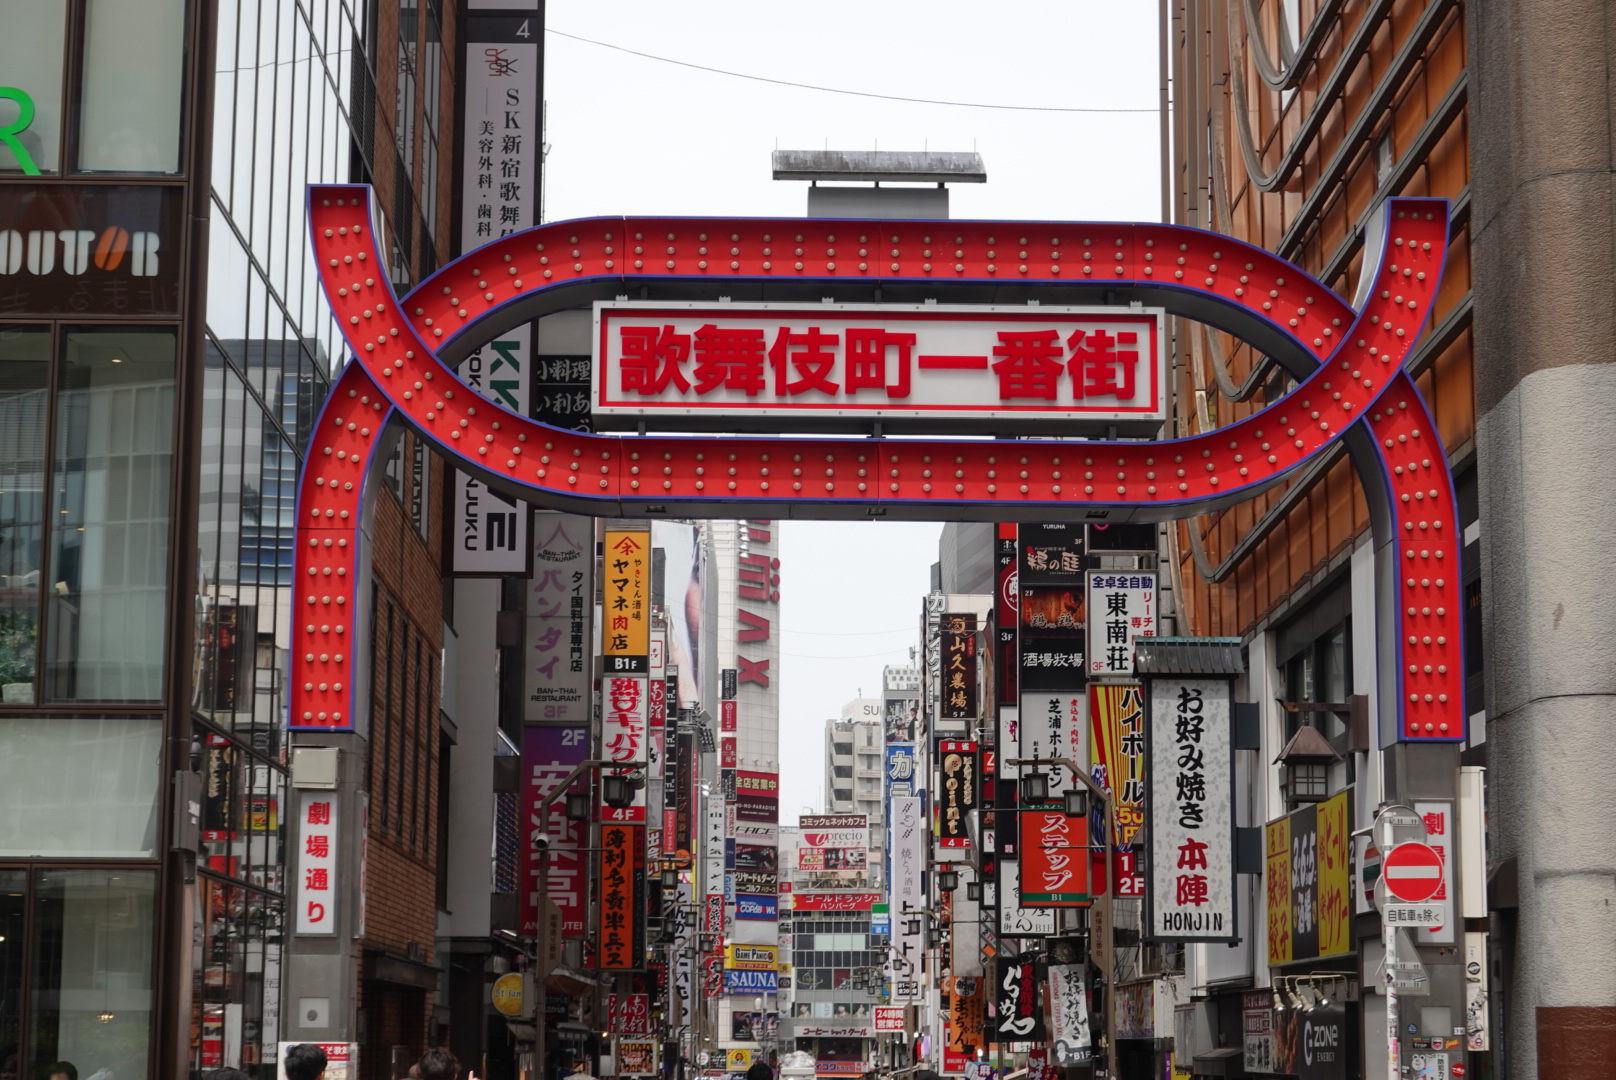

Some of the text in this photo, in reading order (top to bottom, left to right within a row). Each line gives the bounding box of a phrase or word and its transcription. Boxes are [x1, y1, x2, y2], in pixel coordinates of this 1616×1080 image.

[515, 19, 531, 39] 4
[476, 120, 494, 237] 美容外科・歯科
[619, 324, 1138, 400] 歌舞伎町一番街
[537, 552, 581, 562] RESTAURANT
[541, 549, 576, 558] BAN-THAI
[1000, 557, 1011, 565] 4F
[631, 558, 642, 622] やきとん酒場
[1092, 576, 1154, 590] 全卓全自動
[610, 559, 630, 651] ヤマネ肉店
[570, 571, 583, 673] タイ国料理専門店
[1001, 632, 1014, 641] 3F
[1105, 592, 1129, 672] 東南荘
[614, 657, 638, 670] B1F
[1023, 652, 1084, 668] 酒場牧場
[1092, 662, 1104, 671] 3F
[949, 635, 967, 708] 山久農場
[537, 687, 578, 695] BAN-THAI
[531, 694, 583, 703] RESTAURANT
[543, 705, 569, 719] 3F
[561, 729, 586, 746] 2F
[947, 742, 970, 751] 麻雀
[1120, 688, 1144, 804] ハイボール
[1175, 686, 1206, 830] お好み焼き
[736, 777, 777, 791] 全店営業中
[612, 808, 635, 820] 4F
[801, 817, 867, 828] コミック&ネットカフェ
[530, 760, 578, 908] 安楽亭
[736, 826, 777, 836] FACE
[947, 839, 971, 847] 4F
[1040, 814, 1073, 892] ステップ
[306, 802, 330, 924] 劇場通り
[1175, 837, 1210, 907] 本陣
[805, 894, 880, 903] ゴールドラッシュ
[1050, 894, 1063, 902] B1
[820, 902, 856, 910] ハンバーグ
[1162, 911, 1223, 932] HONJIN
[1387, 908, 1441, 923] 自転車を除く
[524, 921, 584, 931] ANUTEI
[735, 947, 767, 960] GAME PANIC
[731, 971, 777, 988] SAUNA
[1073, 1050, 1092, 1061] B1F
[1316, 1051, 1336, 1062] ENERGY
